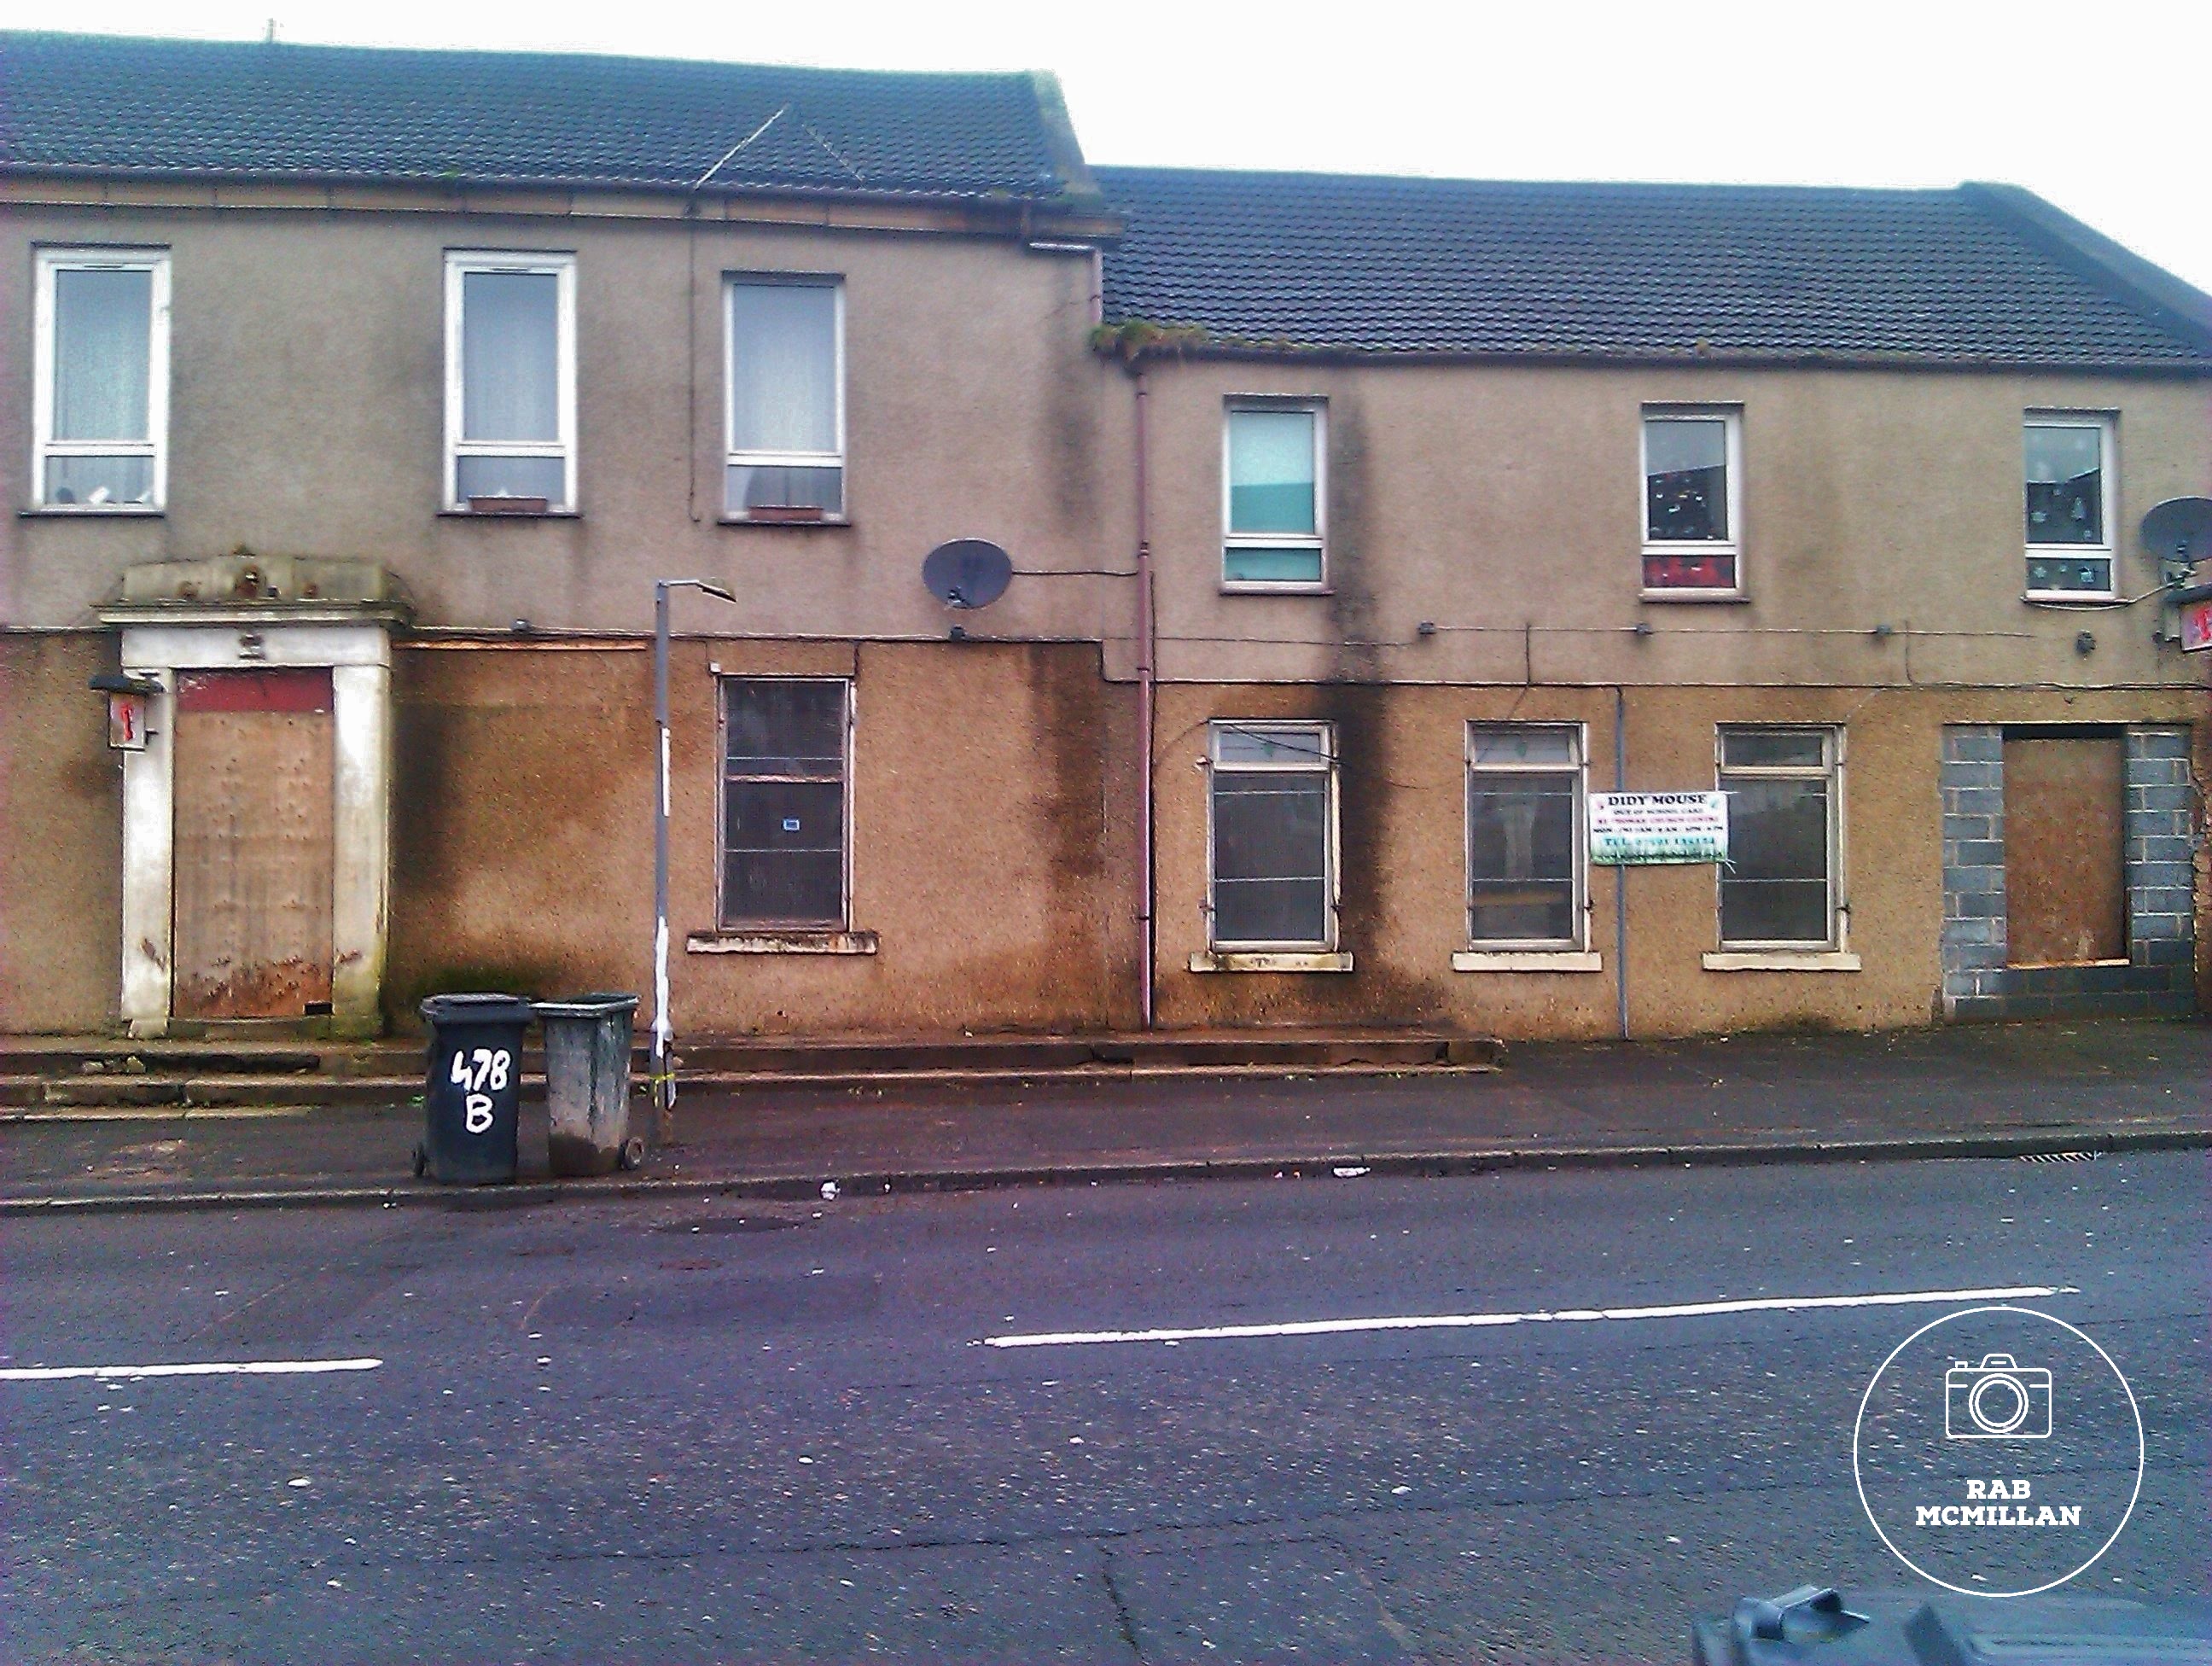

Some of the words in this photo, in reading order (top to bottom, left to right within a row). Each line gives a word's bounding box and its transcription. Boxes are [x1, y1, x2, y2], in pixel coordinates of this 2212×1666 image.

[1609, 795, 1647, 806] DIDY
[1652, 794, 1707, 805] MOUSE
[451, 1049, 510, 1091] 478
[466, 1093, 494, 1133] B
